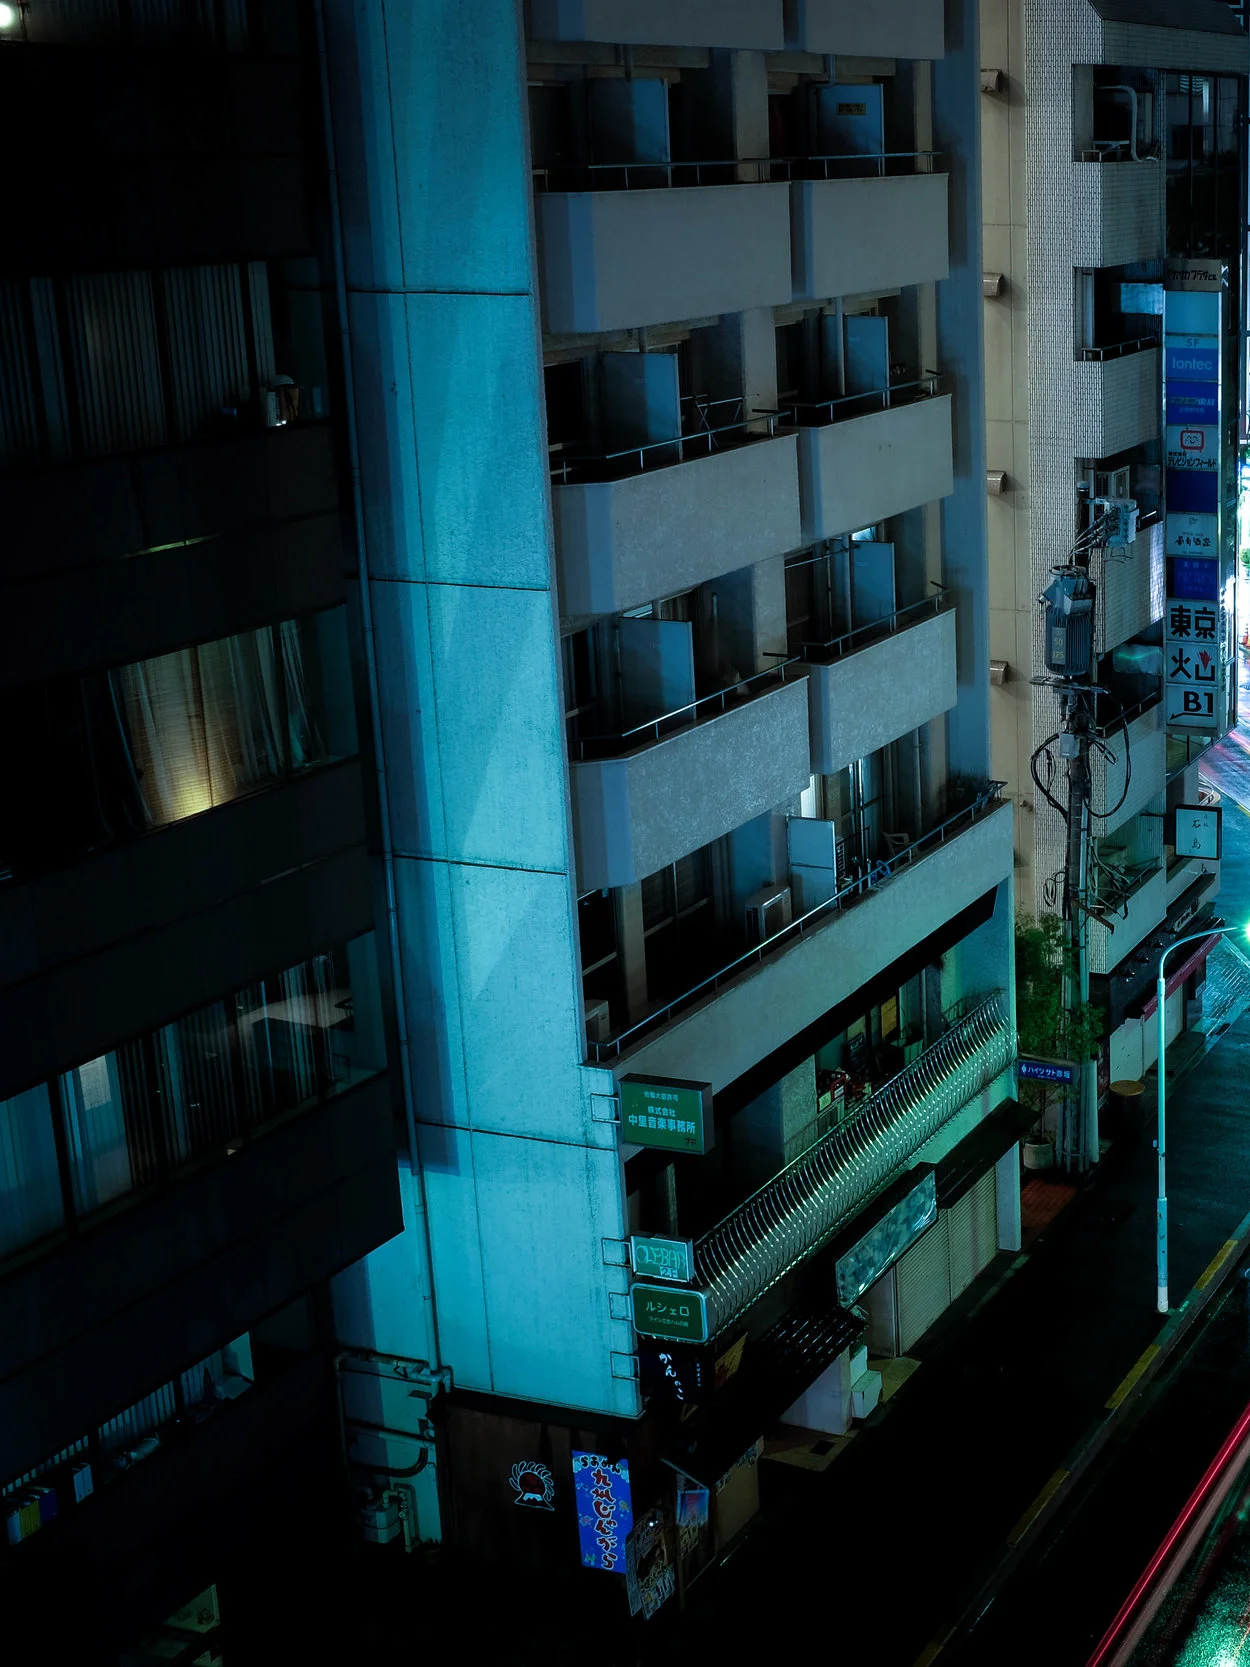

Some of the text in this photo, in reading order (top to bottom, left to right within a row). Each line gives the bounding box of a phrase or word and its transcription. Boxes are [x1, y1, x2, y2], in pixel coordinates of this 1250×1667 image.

[1170, 604, 1216, 639] 東京
[1183, 690, 1214, 714] B1
[647, 1105, 677, 1117] 株式会社
[628, 1113, 696, 1135] 中里音楽事務所
[645, 1300, 690, 1317] ルシェロ
